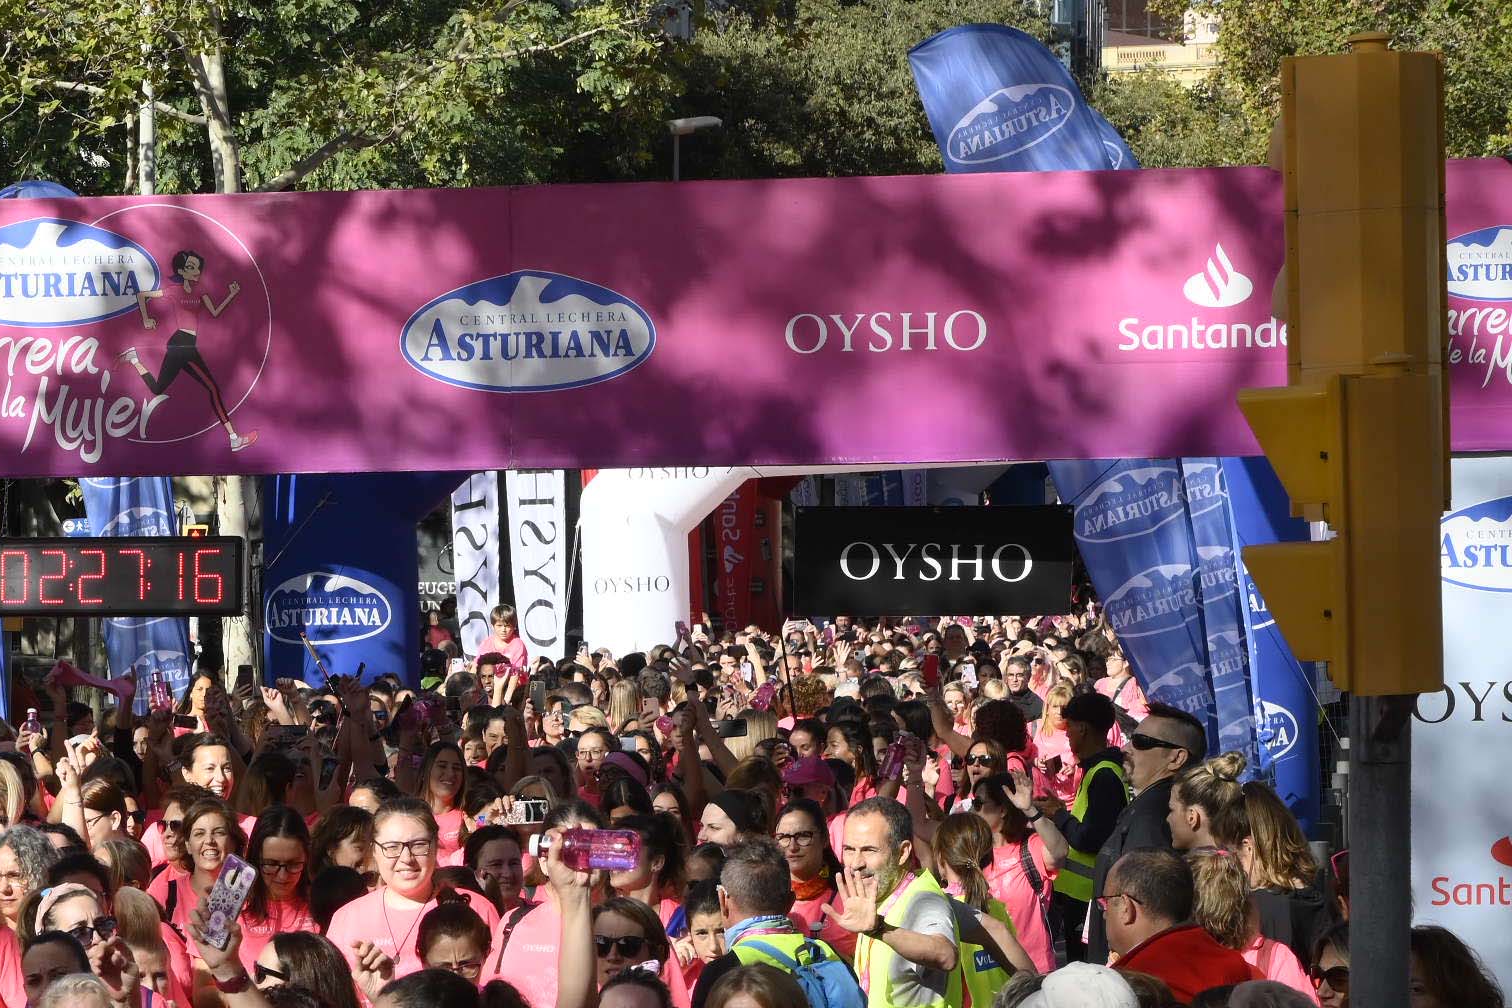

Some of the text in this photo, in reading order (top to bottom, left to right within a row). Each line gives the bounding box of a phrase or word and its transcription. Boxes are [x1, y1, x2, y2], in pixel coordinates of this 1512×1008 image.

[1447, 261, 1512, 282] STUR
[460, 311, 627, 326] CENTRAL LECHERA
[785, 310, 987, 354] OYSHO
[1448, 307, 1512, 336] arre
[420, 317, 635, 362] ASTURIANA
[1118, 316, 1288, 351] Santande
[1469, 337, 1486, 364] la
[1, 377, 25, 418] la
[21, 369, 170, 463] Mujer
[839, 542, 1034, 583] OYSHO
[1440, 532, 1512, 568] ASTU
[1, 550, 222, 604] 02:27:16
[418, 581, 456, 595] EUGE
[593, 576, 671, 594] OYSHO
[329, 596, 379, 605] LECHERA
[269, 602, 381, 629] ASTURIANA
[1431, 876, 1512, 906] Sant
